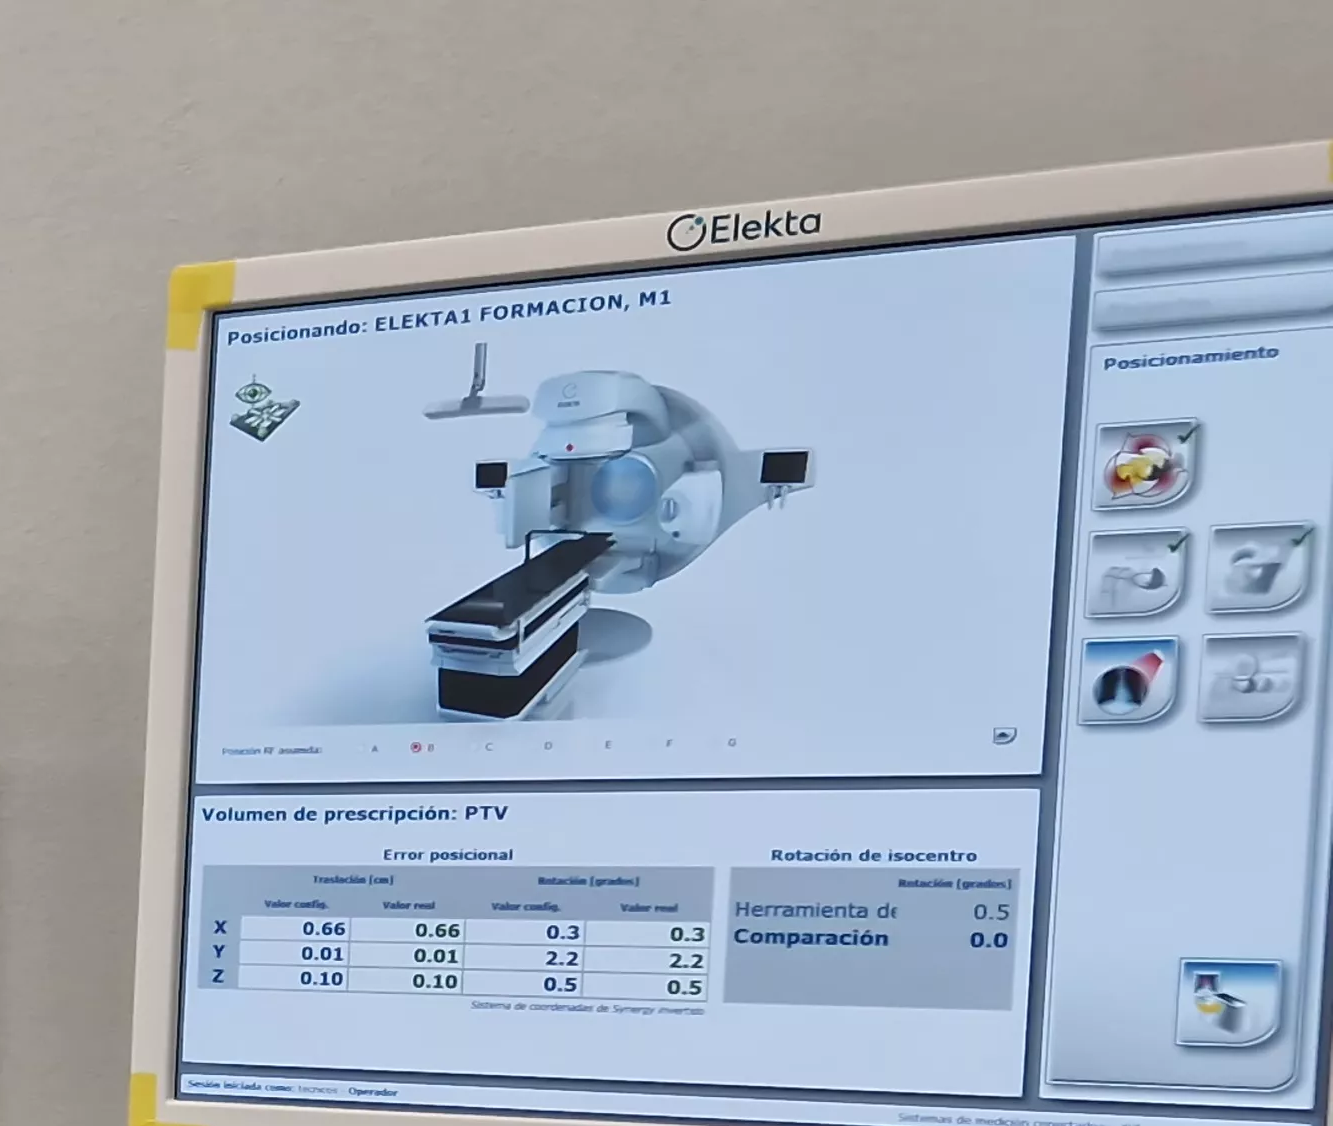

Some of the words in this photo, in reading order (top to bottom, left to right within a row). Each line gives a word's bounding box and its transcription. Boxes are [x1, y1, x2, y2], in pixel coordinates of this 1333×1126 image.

[711, 210, 822, 244] Elekta
[227, 319, 369, 346] Posicionando:
[374, 307, 472, 333] ELEKTA1
[479, 293, 631, 323] FORMACION,
[638, 289, 672, 308] M1
[1103, 346, 1280, 371] Posicionamiento
[202, 806, 287, 824] Volumen
[293, 806, 318, 822] de
[325, 804, 458, 829] prescripción:
[464, 804, 509, 822] PTV
[383, 849, 425, 862] Error
[428, 849, 514, 866] posicional
[771, 848, 853, 863] Rotación
[858, 847, 882, 863] de
[888, 848, 978, 863] isocentro
[264, 900, 293, 909] Valor
[383, 901, 411, 910] Valor
[492, 902, 521, 911] Valor
[620, 903, 650, 913] Valor
[734, 901, 871, 921] Herramienta
[973, 902, 1011, 923] 0.5
[212, 919, 227, 935] X
[302, 921, 346, 936] 0.66
[415, 923, 461, 938] 0.66
[546, 924, 580, 940] 0.3
[670, 926, 706, 942] 0.3
[733, 929, 890, 950] Comparación
[969, 931, 1009, 950] 0.0
[212, 943, 225, 959] Y
[301, 946, 344, 961] 0.01
[413, 948, 459, 964] 0.01
[545, 951, 579, 966] 2.2
[668, 953, 704, 969] 2.2
[212, 968, 225, 984] Z
[300, 971, 344, 986] 0.10
[412, 973, 458, 989] 0.10
[543, 977, 578, 992] 0.5
[666, 979, 702, 995] 0.5
[348, 1086, 399, 1098] Operador
[956, 1115, 973, 1125] de
